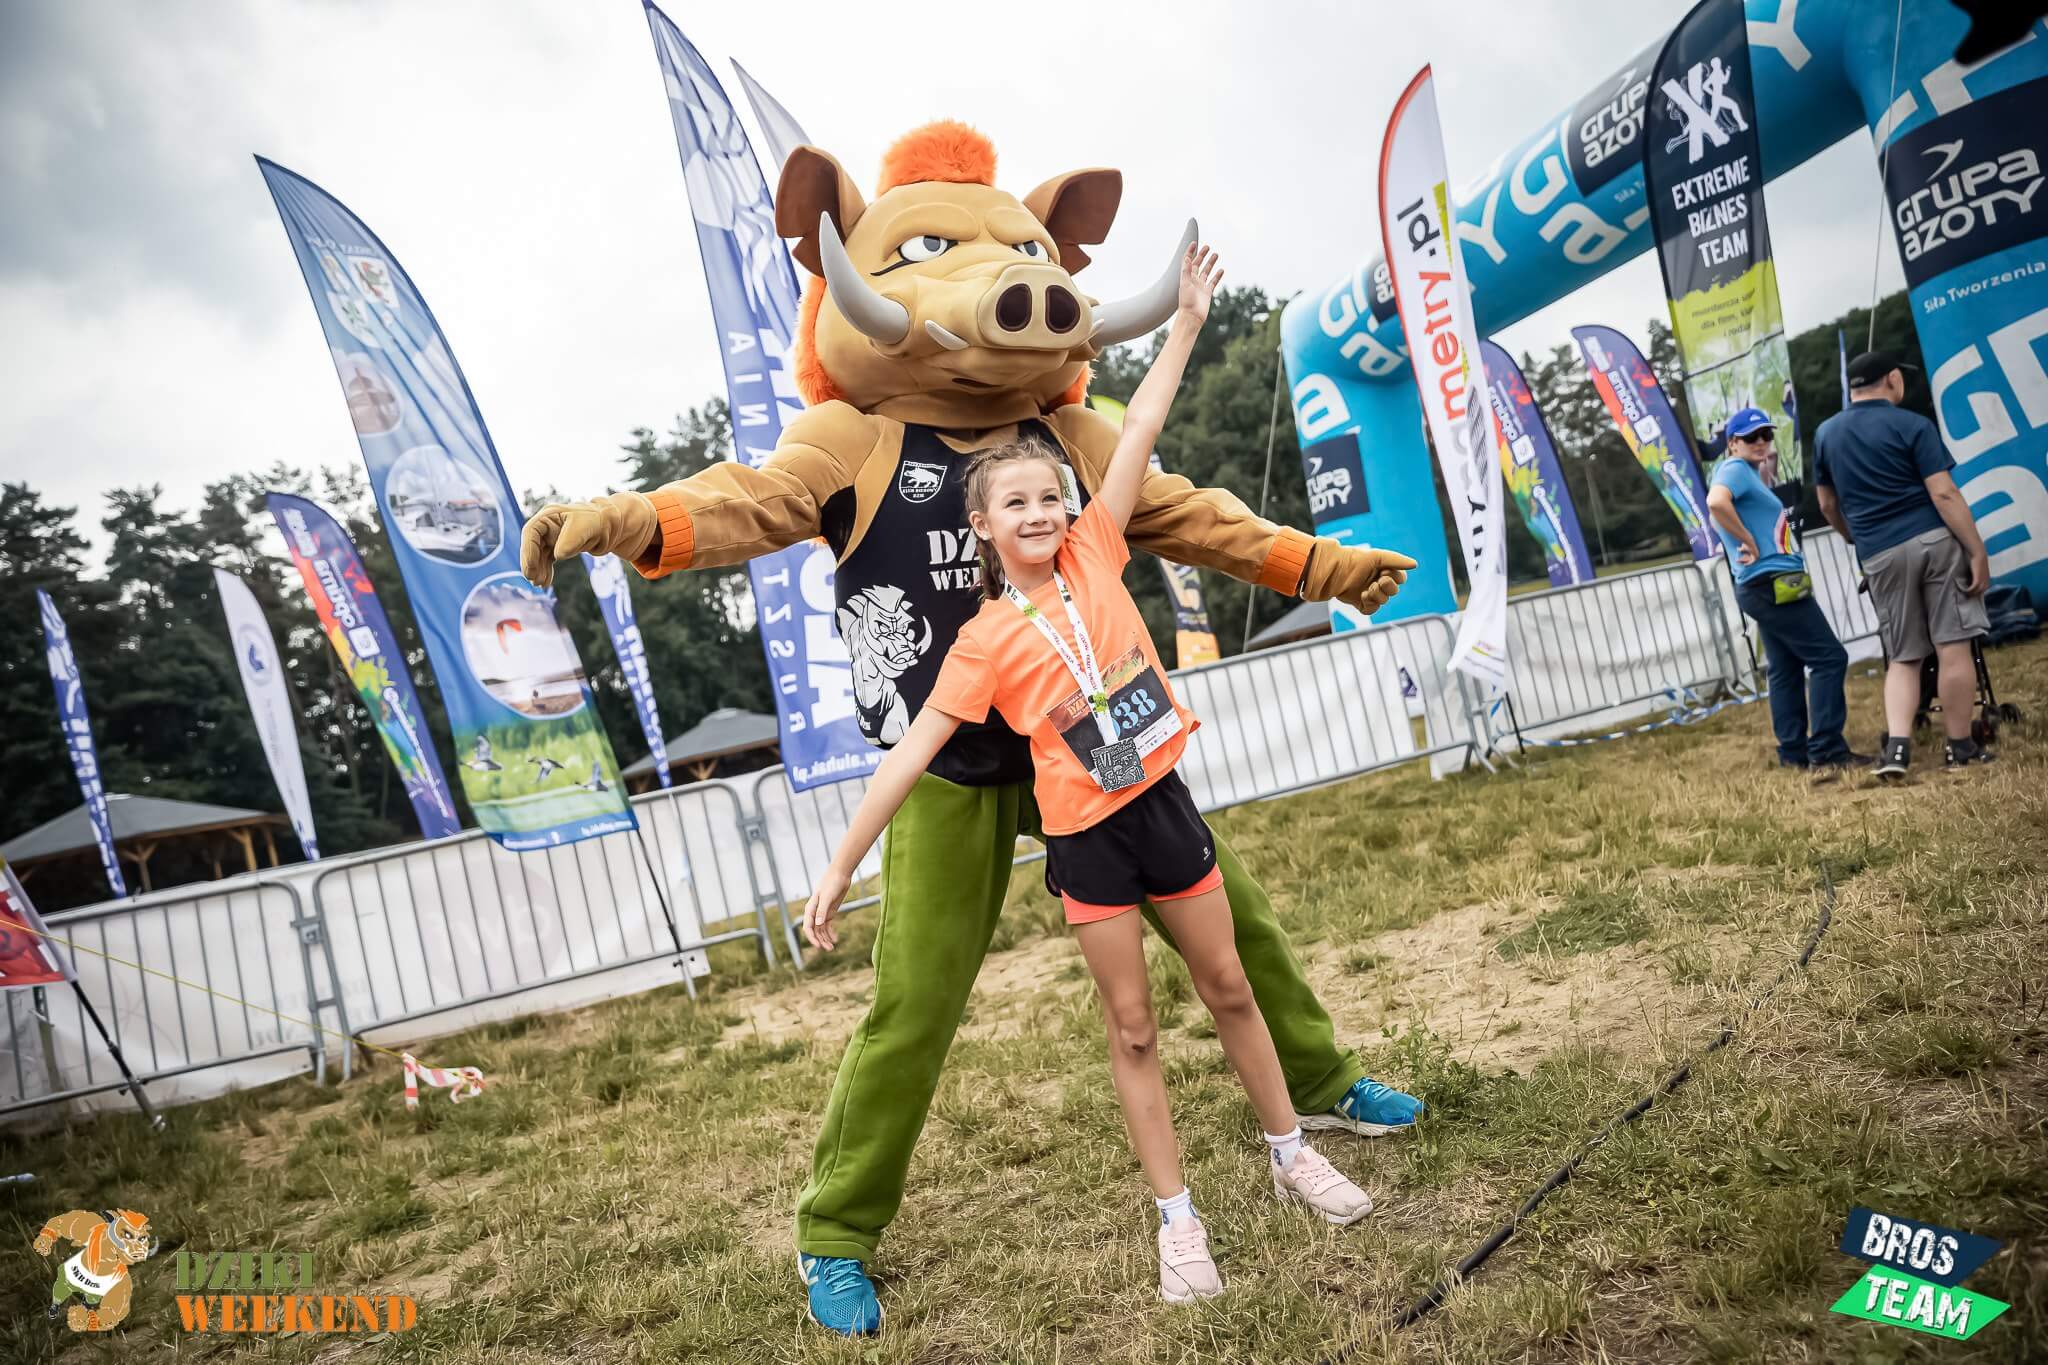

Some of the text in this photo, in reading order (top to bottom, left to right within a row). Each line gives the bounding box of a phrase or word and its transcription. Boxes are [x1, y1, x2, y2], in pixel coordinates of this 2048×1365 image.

[1671, 155, 1751, 210] EXTREME
[1688, 194, 1747, 237] BIZNES
[1698, 228, 1749, 268] TEAM
[1947, 260, 2046, 302] Tworzenia
[1112, 688, 1157, 737] 38
